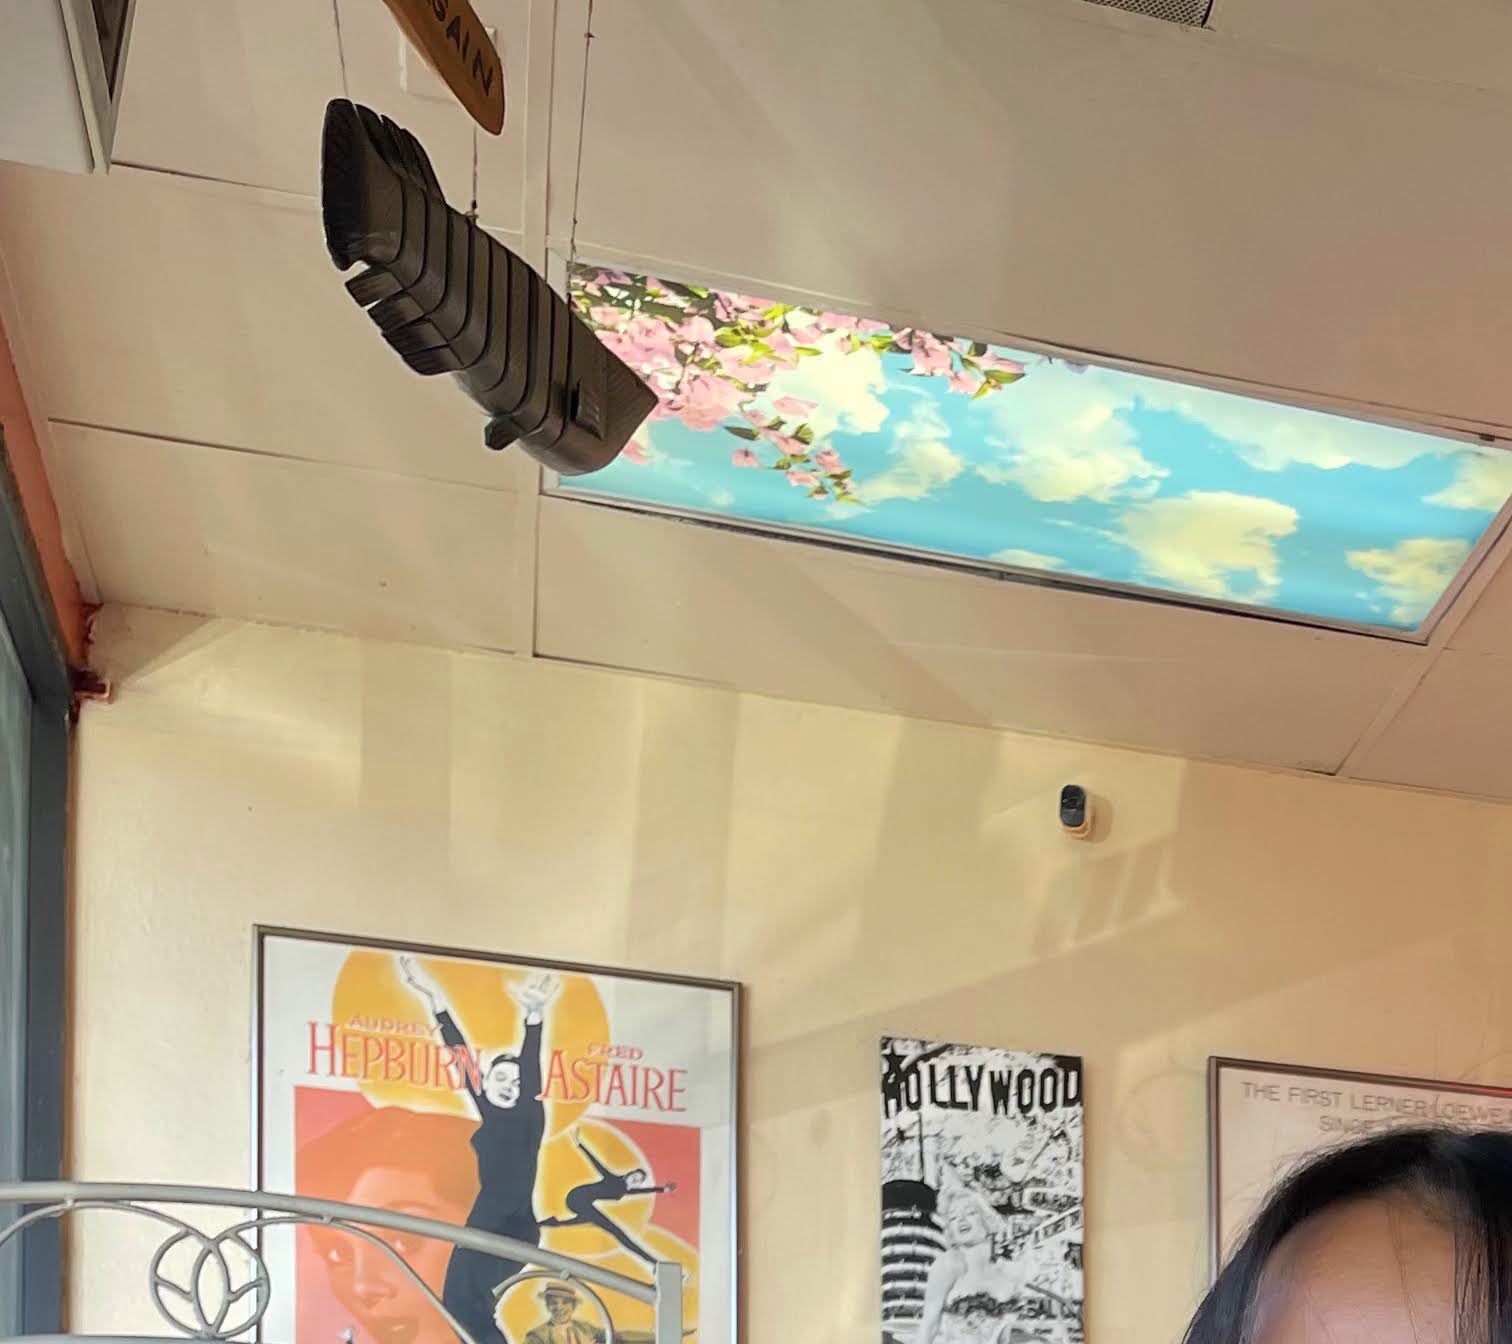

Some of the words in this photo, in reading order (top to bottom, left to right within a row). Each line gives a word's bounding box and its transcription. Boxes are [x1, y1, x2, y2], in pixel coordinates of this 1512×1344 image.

[350, 1016, 444, 1037] AUDREY
[587, 1042, 644, 1061] FRED
[307, 1020, 483, 1096] HEPBURN
[535, 1049, 689, 1112] ASTAIRE
[884, 1063, 1081, 1118] HOLLYWOOD
[1241, 1081, 1281, 1102] THE
[1287, 1086, 1343, 1109] FIRST
